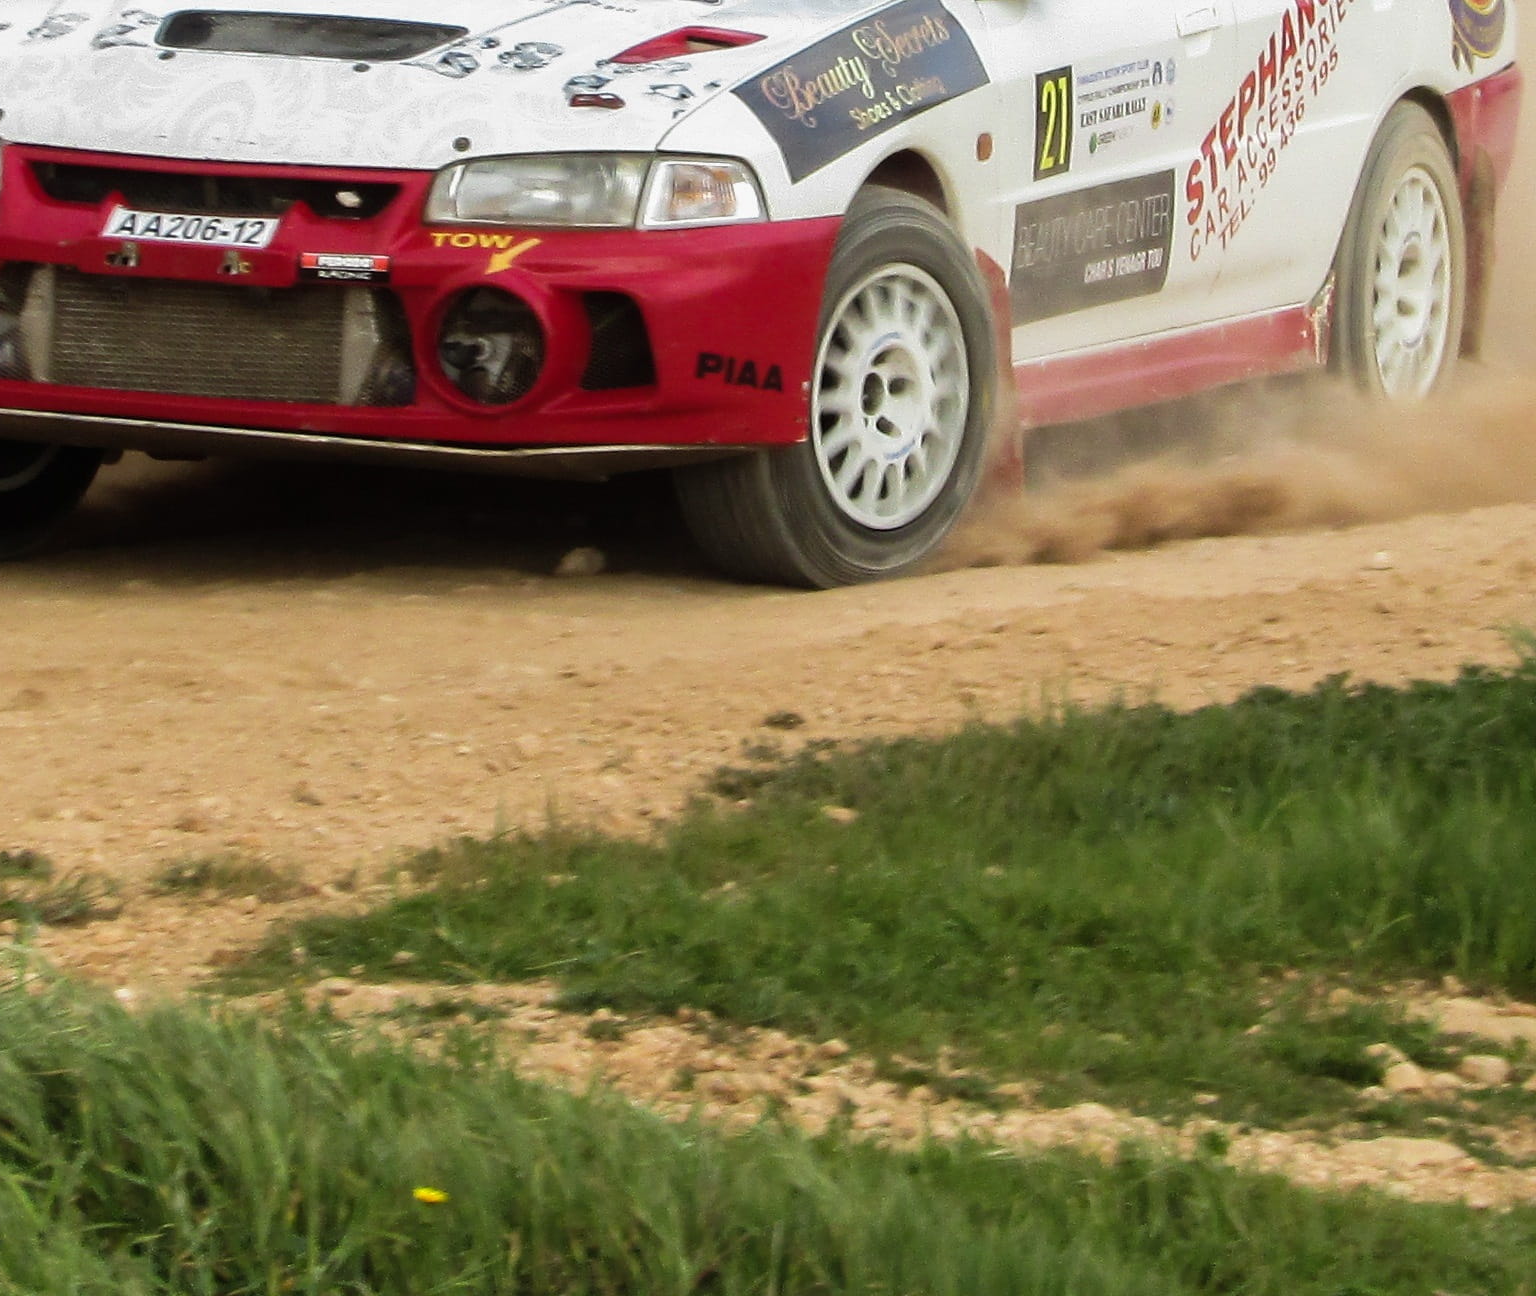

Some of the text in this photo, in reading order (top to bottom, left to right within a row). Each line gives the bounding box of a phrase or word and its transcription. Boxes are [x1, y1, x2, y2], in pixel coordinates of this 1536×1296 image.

[761, 15, 951, 130] Beauty Secrets
[1040, 76, 1067, 170] 21
[1080, 97, 1146, 128] EAST SAFARI RALLY
[1259, 146, 1277, 189] 99
[1279, 94, 1306, 150] 436
[1310, 44, 1340, 97] 195
[114, 213, 265, 245] AA206-12
[430, 232, 514, 249] TOW
[1015, 216, 1067, 269] BEAUTY
[1116, 193, 1170, 245] CENTER
[1189, 187, 1231, 262] CAR
[694, 352, 784, 393] PIAA
